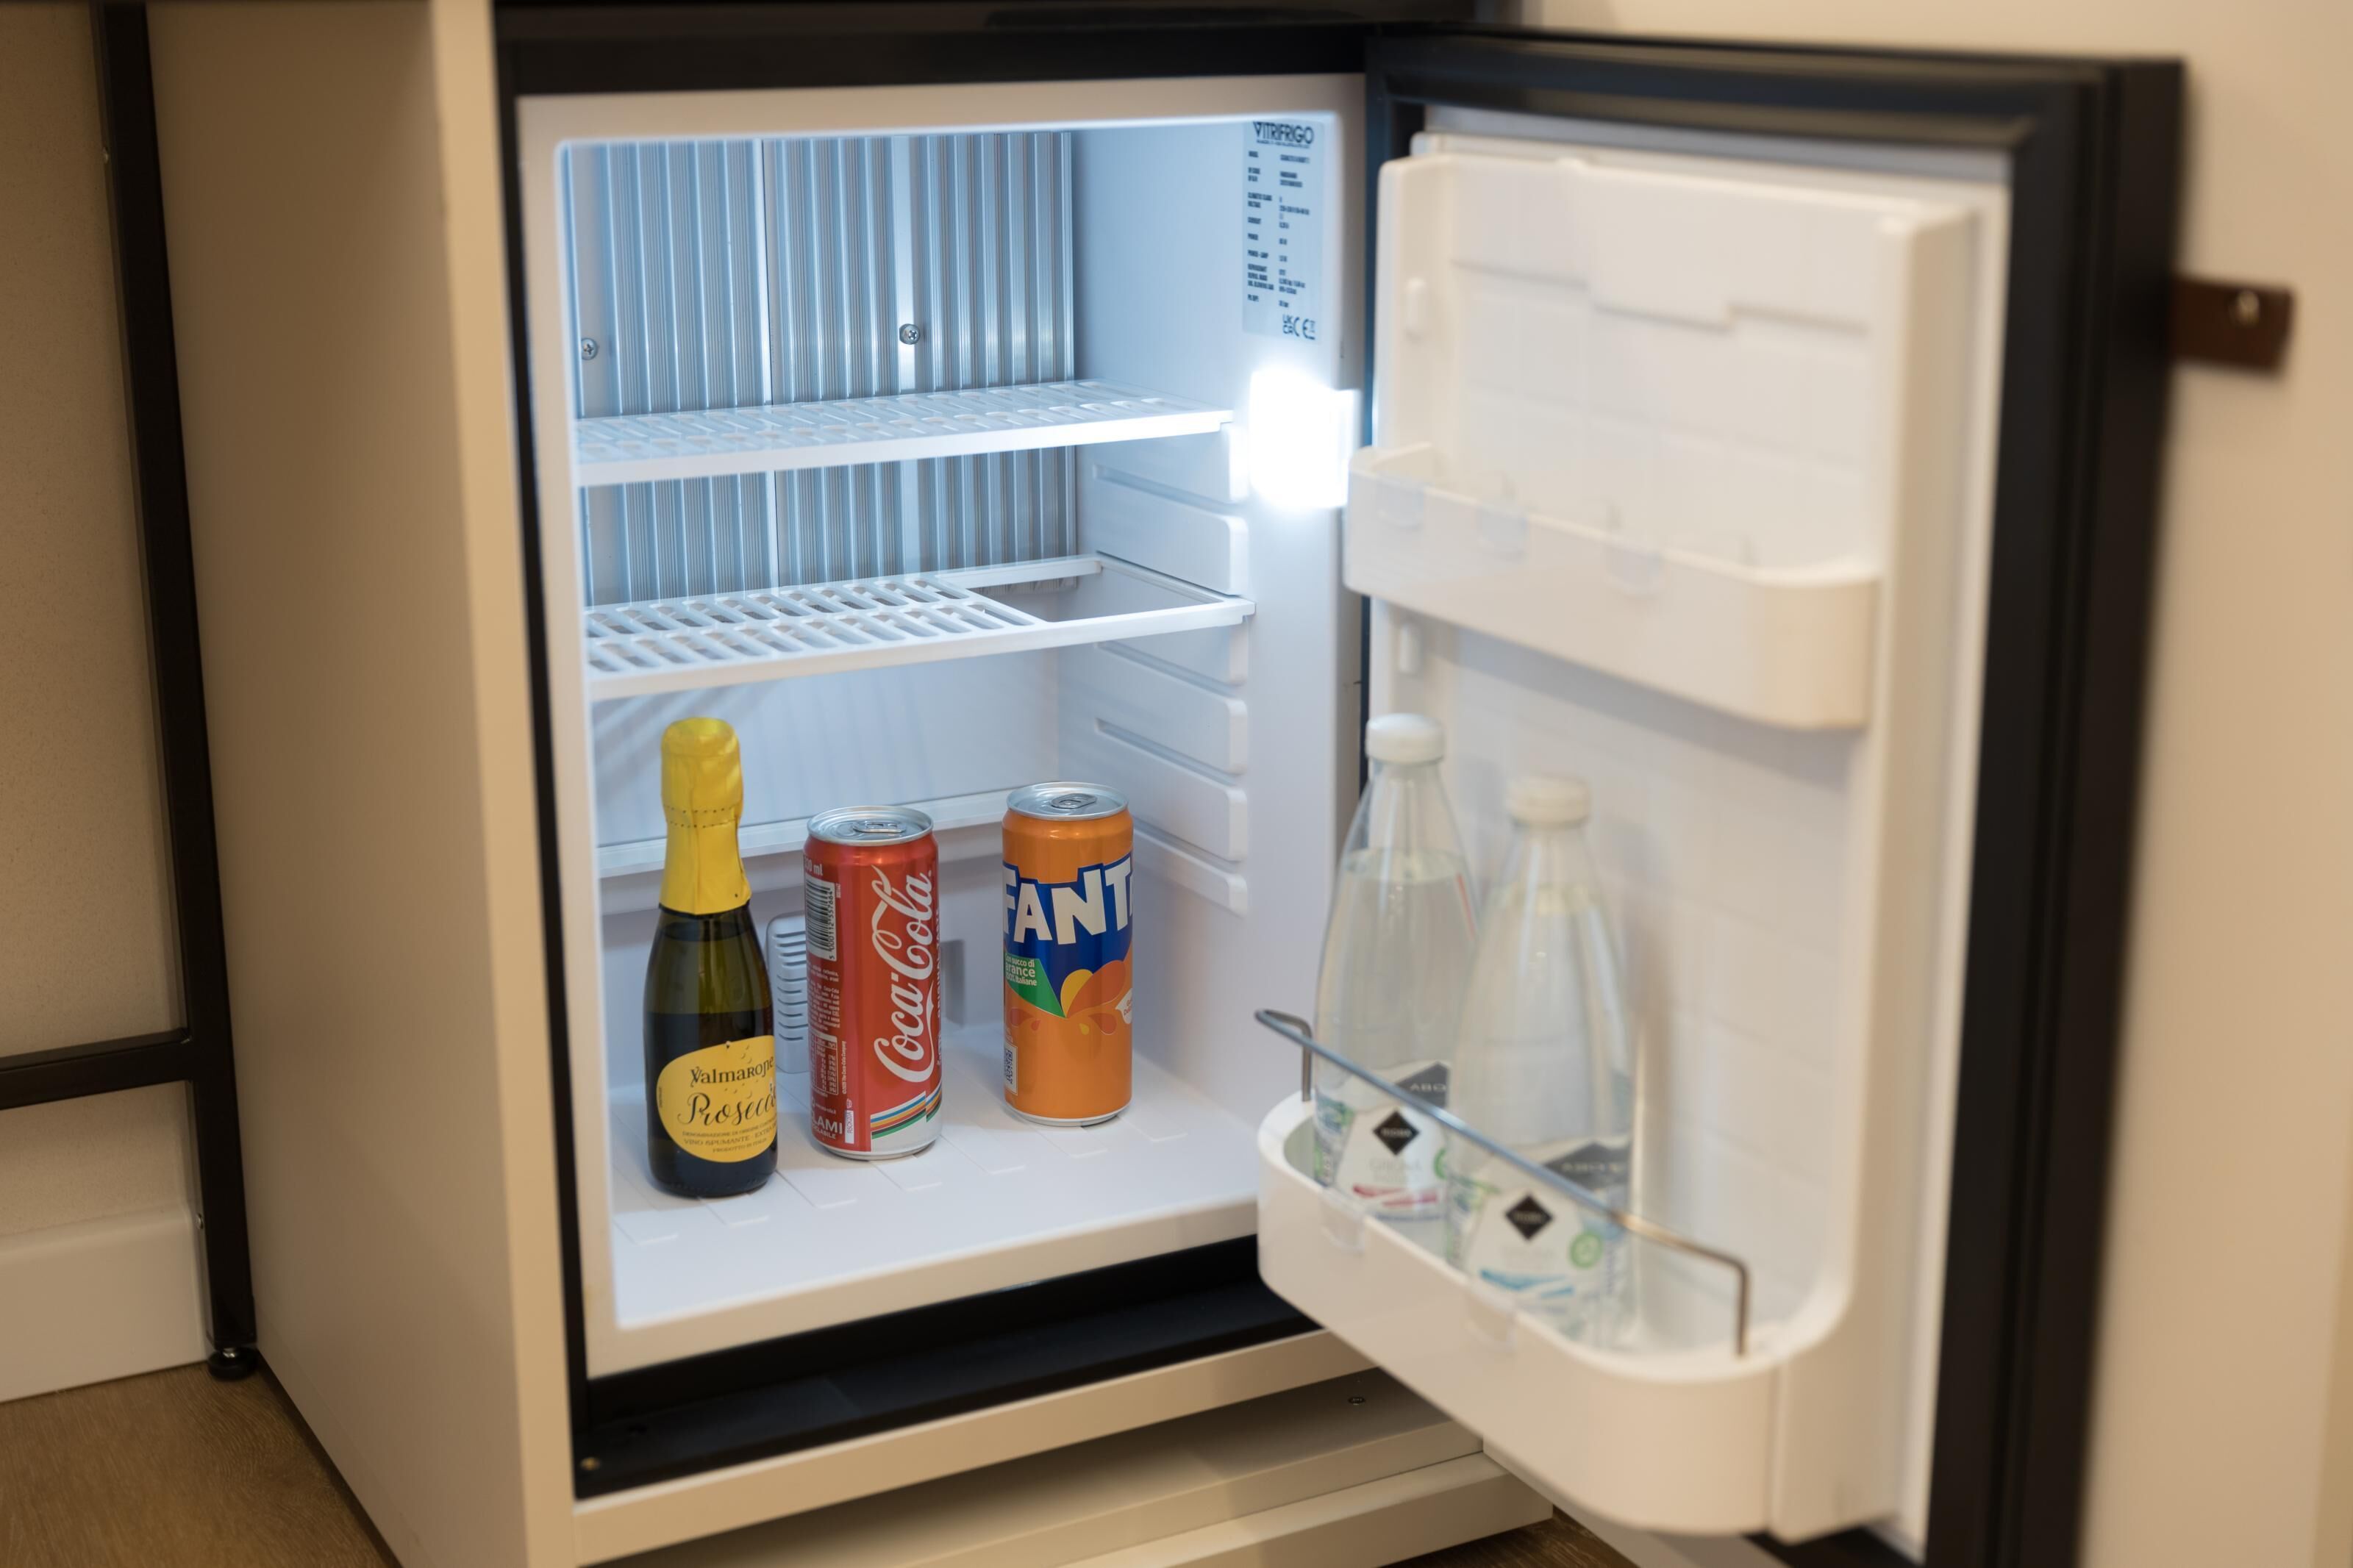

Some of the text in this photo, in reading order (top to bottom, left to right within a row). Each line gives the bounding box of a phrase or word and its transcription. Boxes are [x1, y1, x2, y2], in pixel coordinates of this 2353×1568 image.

[1003, 857, 1133, 945] FANT
[1011, 957, 1027, 967] succo
[1028, 959, 1035, 967] di
[871, 864, 934, 1083] Coca-Cola
[1005, 963, 1036, 978] arance
[1015, 975, 1038, 987] Italiane
